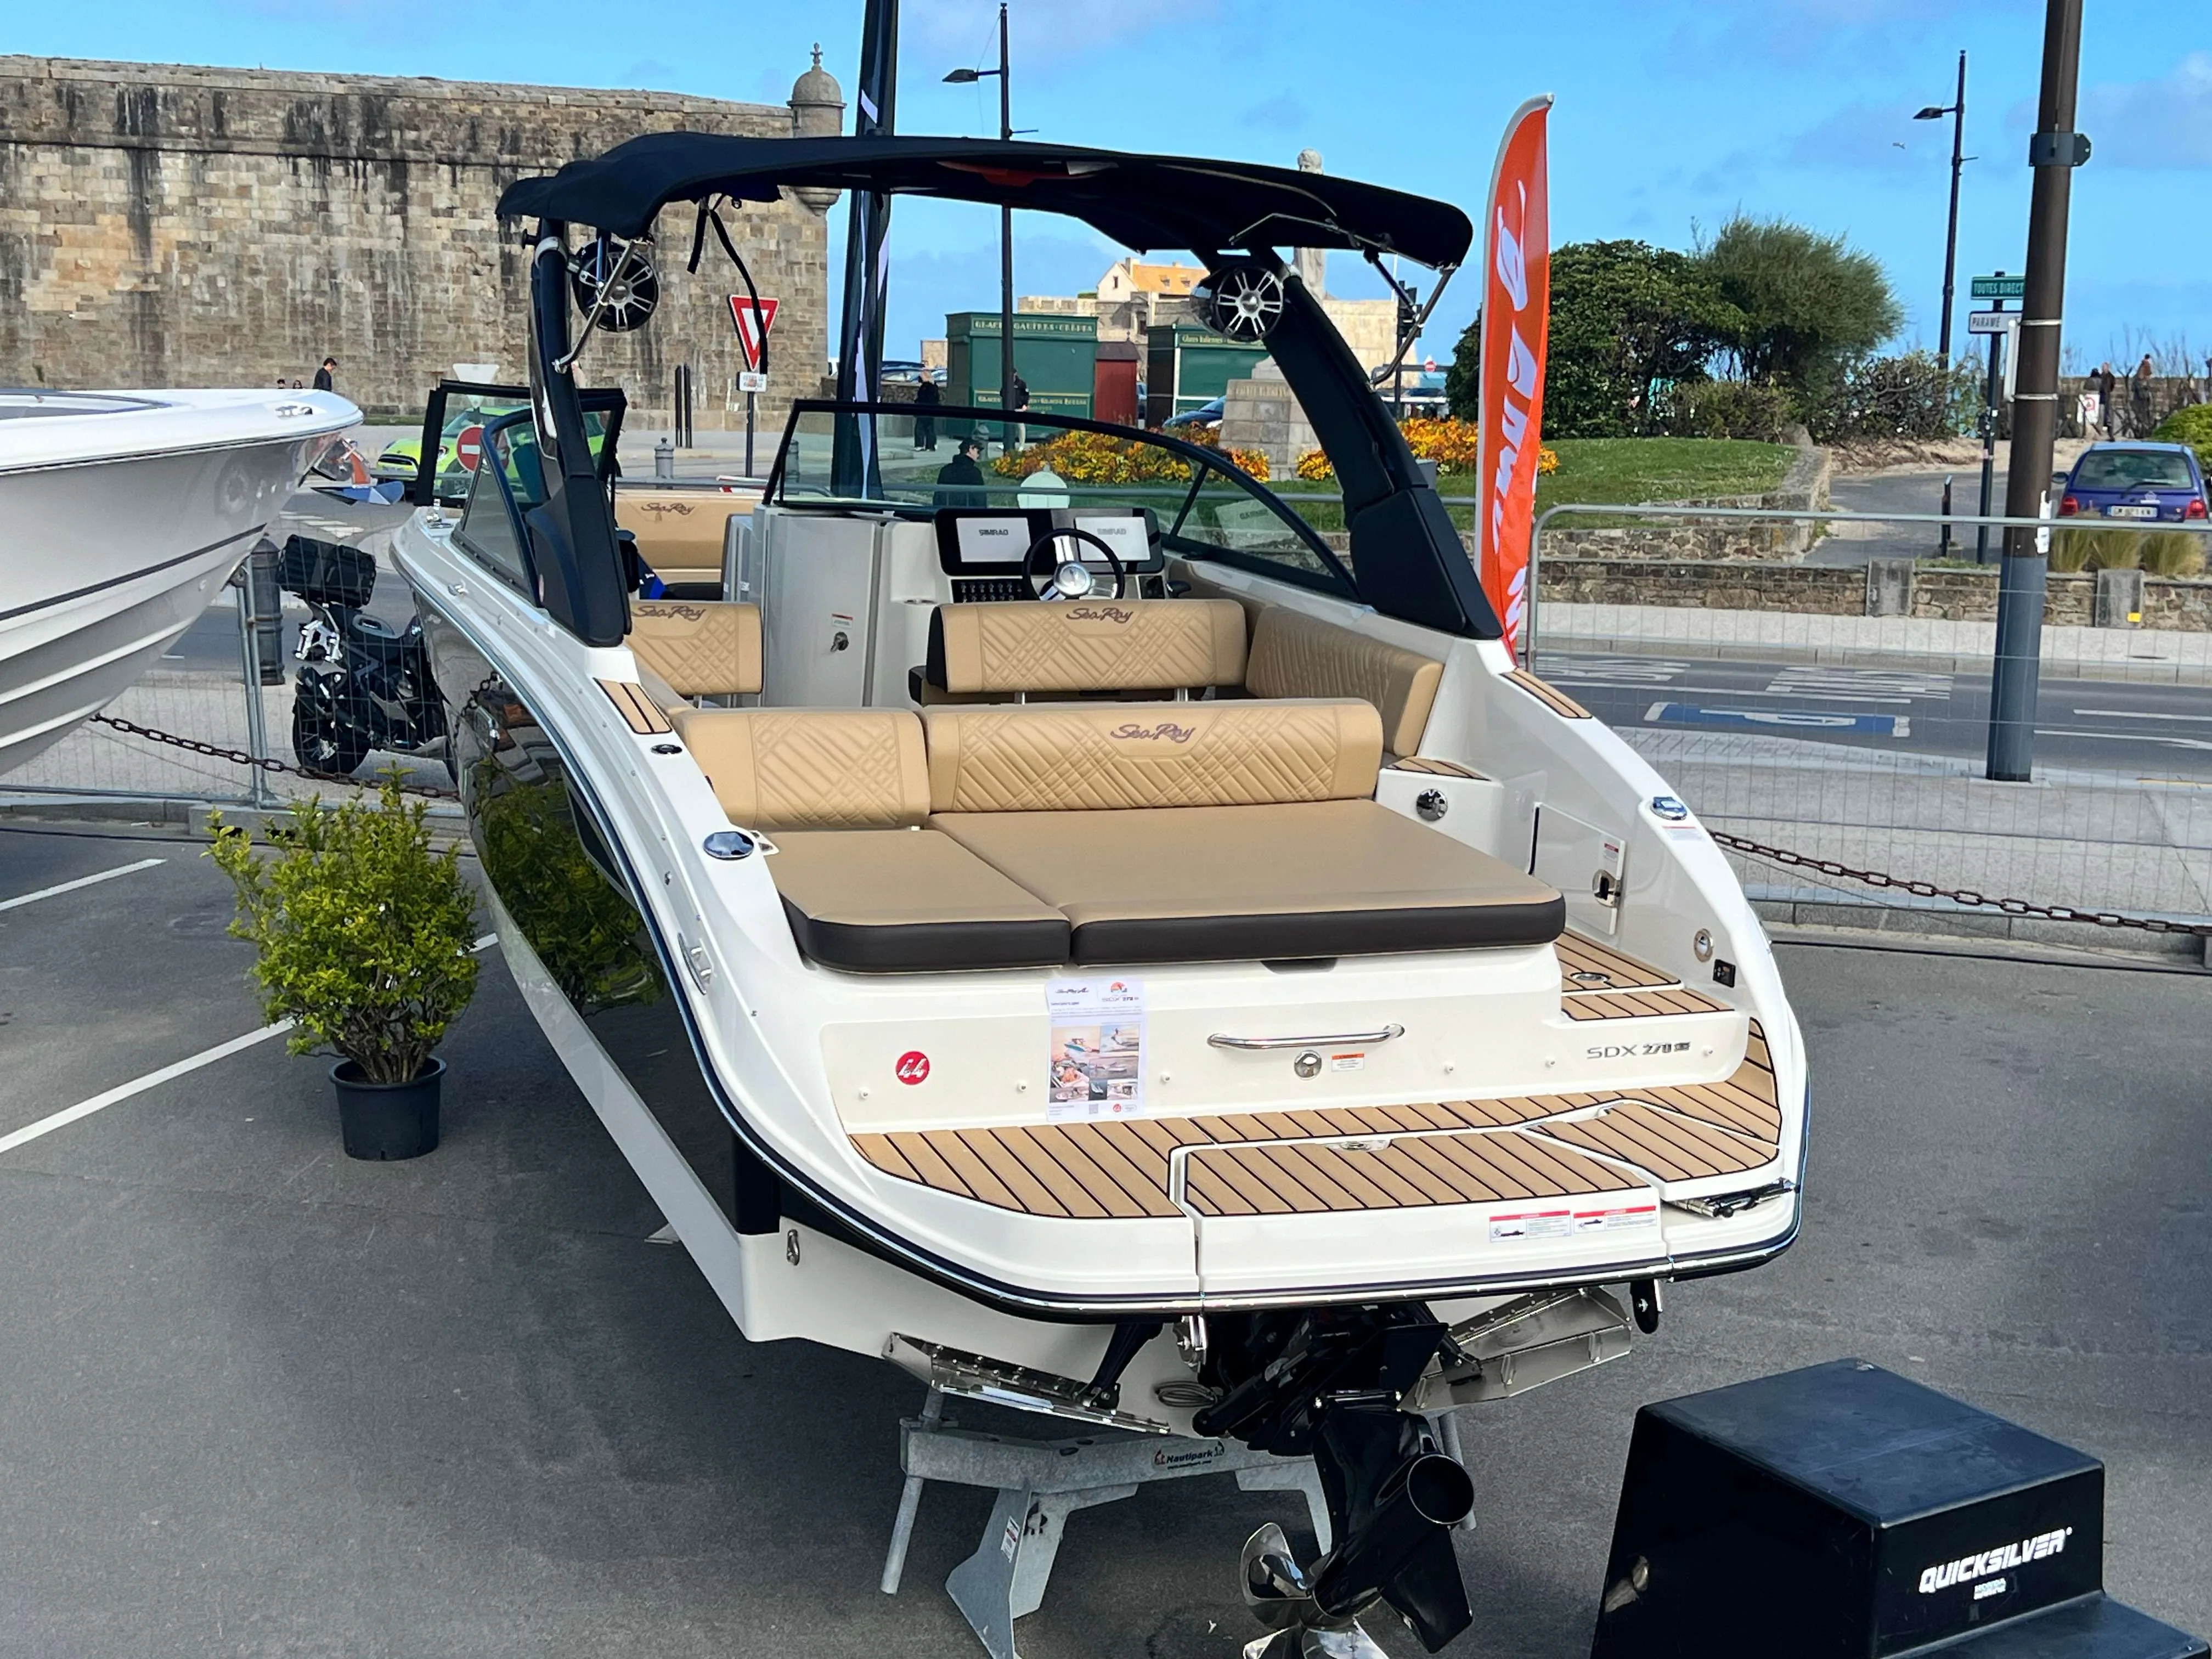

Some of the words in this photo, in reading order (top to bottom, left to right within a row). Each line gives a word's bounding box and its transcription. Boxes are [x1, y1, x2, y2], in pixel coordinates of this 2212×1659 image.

[1974, 283, 1997, 294] TOUTES
[1999, 283, 2024, 294] DIRECT
[975, 321, 1002, 329] GLACE
[1587, 1045, 1638, 1059] SDX
[1642, 1043, 1672, 1055] 270
[1166, 1450, 1212, 1464] Nautipark
[1918, 1528, 2066, 1593] QUICKSILVER
